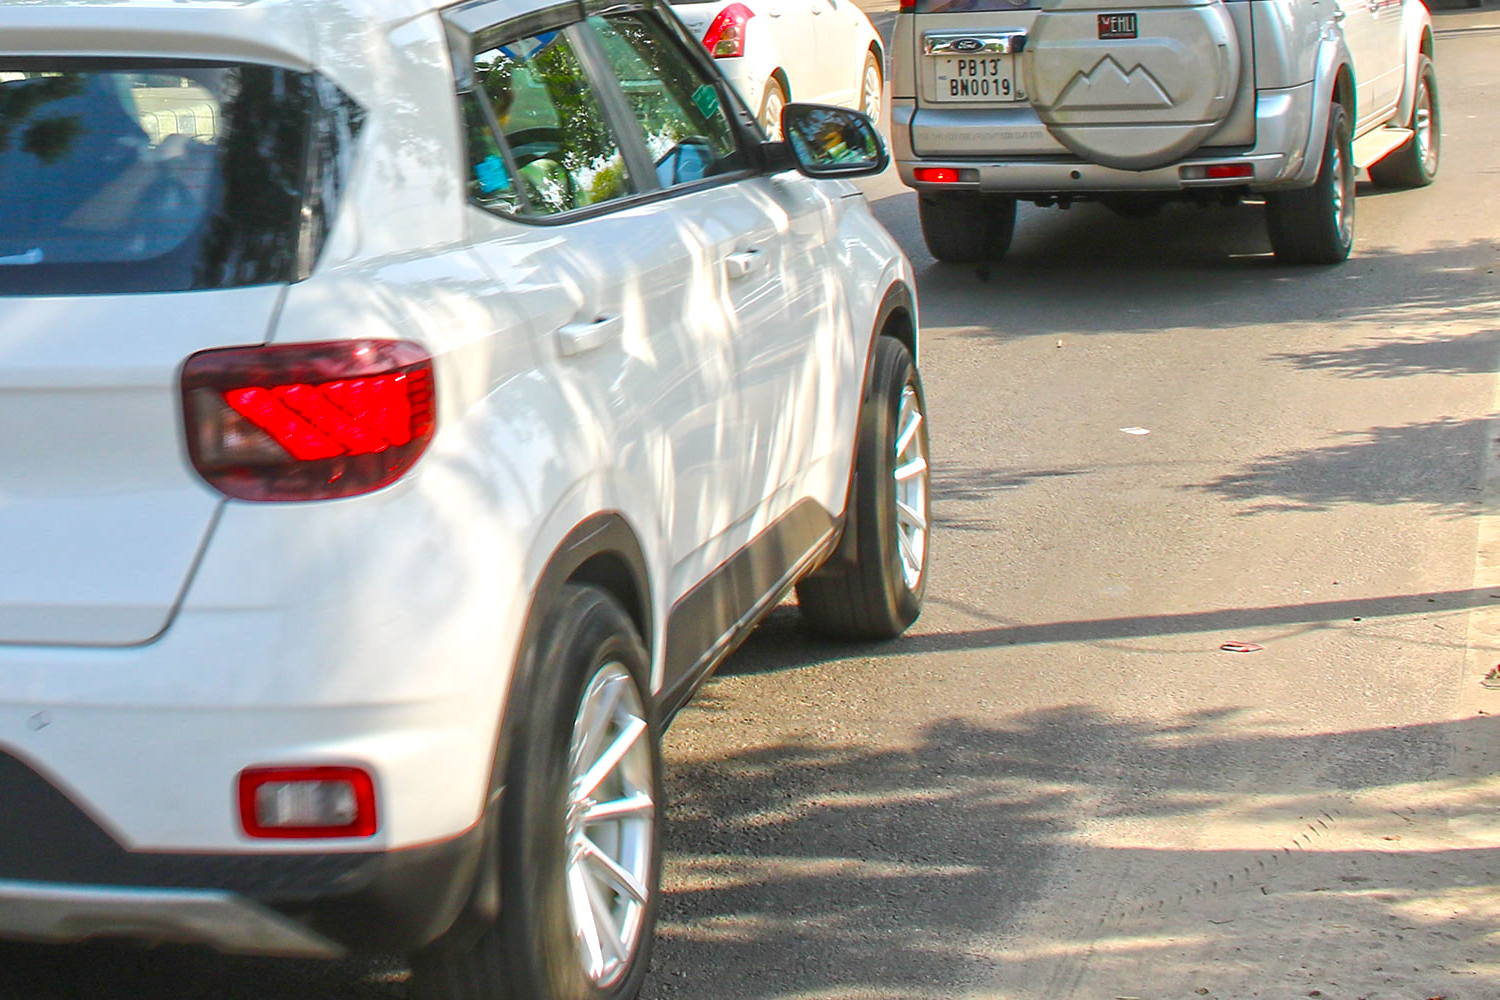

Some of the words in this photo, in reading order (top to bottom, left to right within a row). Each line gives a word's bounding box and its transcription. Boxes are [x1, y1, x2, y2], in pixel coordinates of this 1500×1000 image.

[958, 41, 977, 50] Ford
[958, 59, 998, 77] PB13
[950, 79, 1011, 96] BN0019
